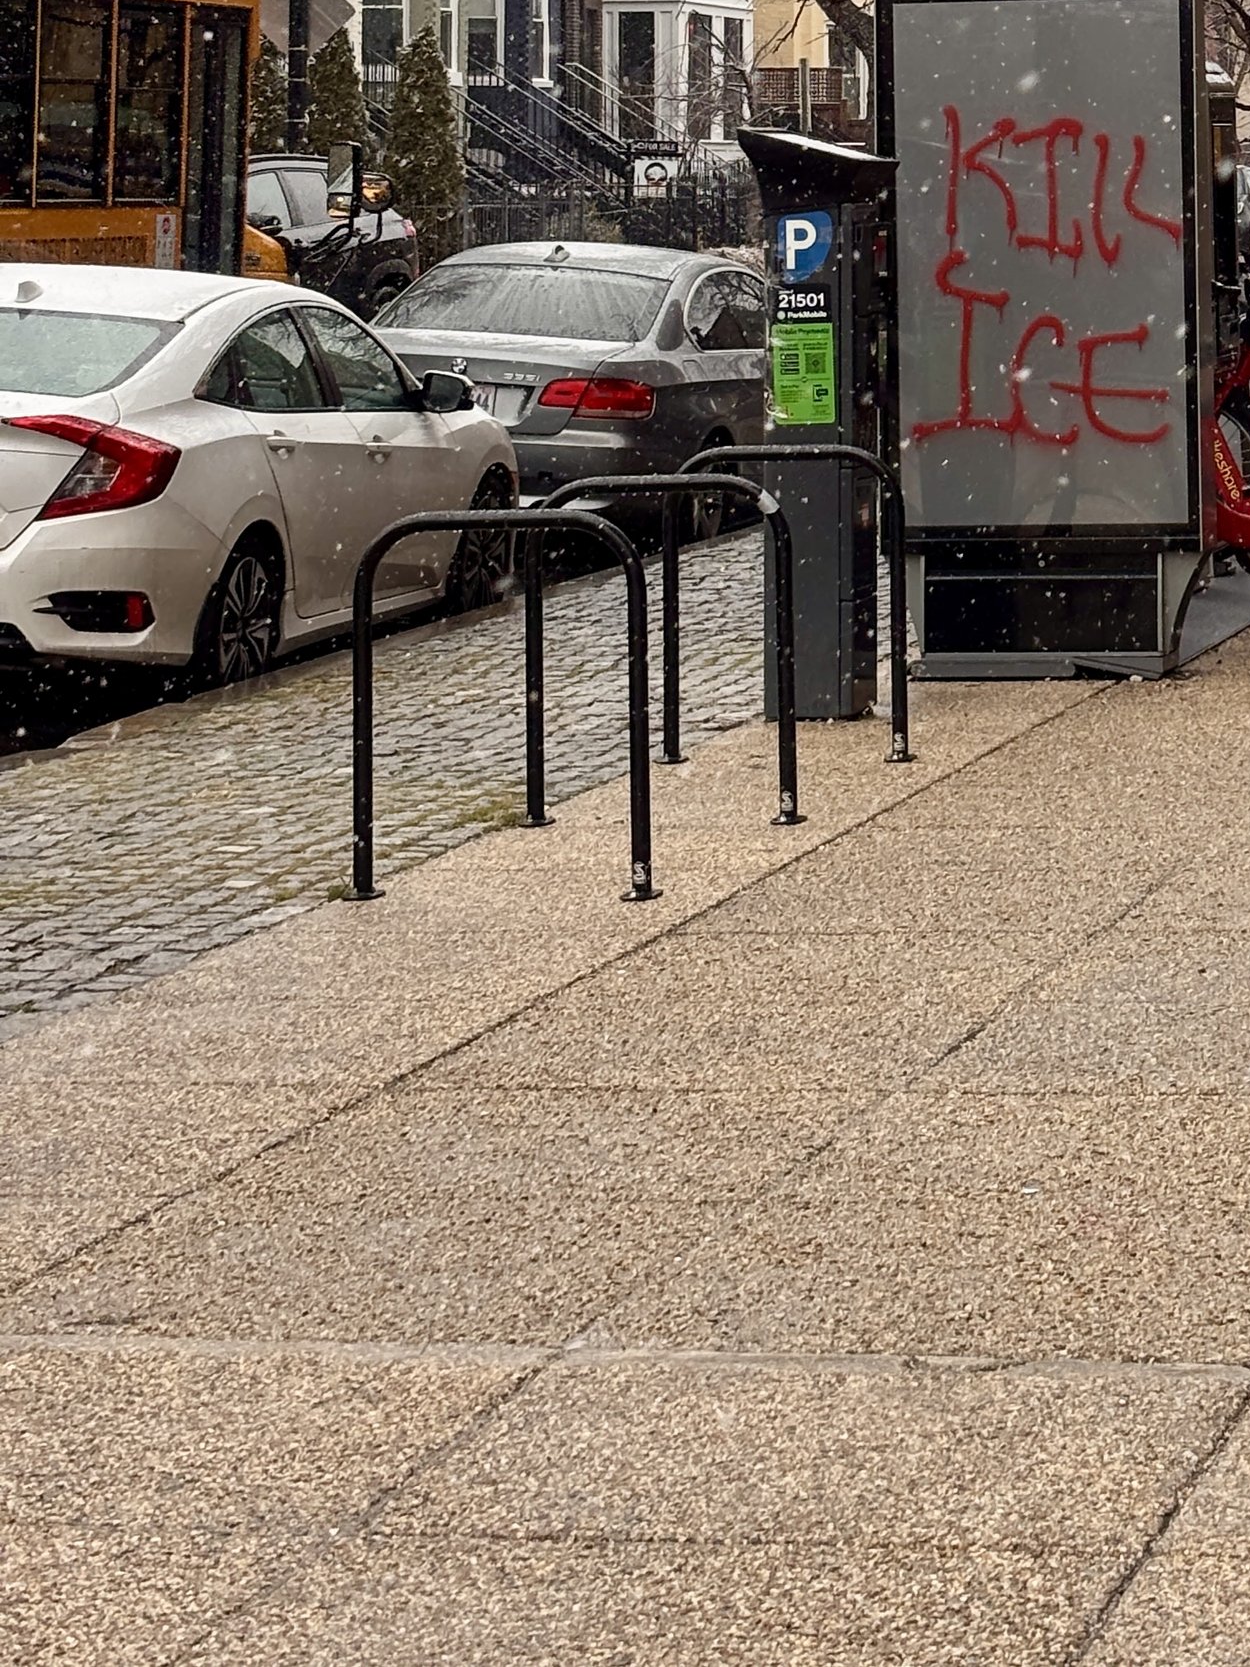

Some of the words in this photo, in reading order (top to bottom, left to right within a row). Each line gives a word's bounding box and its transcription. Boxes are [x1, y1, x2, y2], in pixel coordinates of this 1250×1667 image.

[659, 143, 676, 151] SALE
[785, 220, 817, 270] P
[778, 293, 825, 308] 21501
[787, 311, 828, 319] ParkMobile
[912, 248, 1171, 446] ICE
